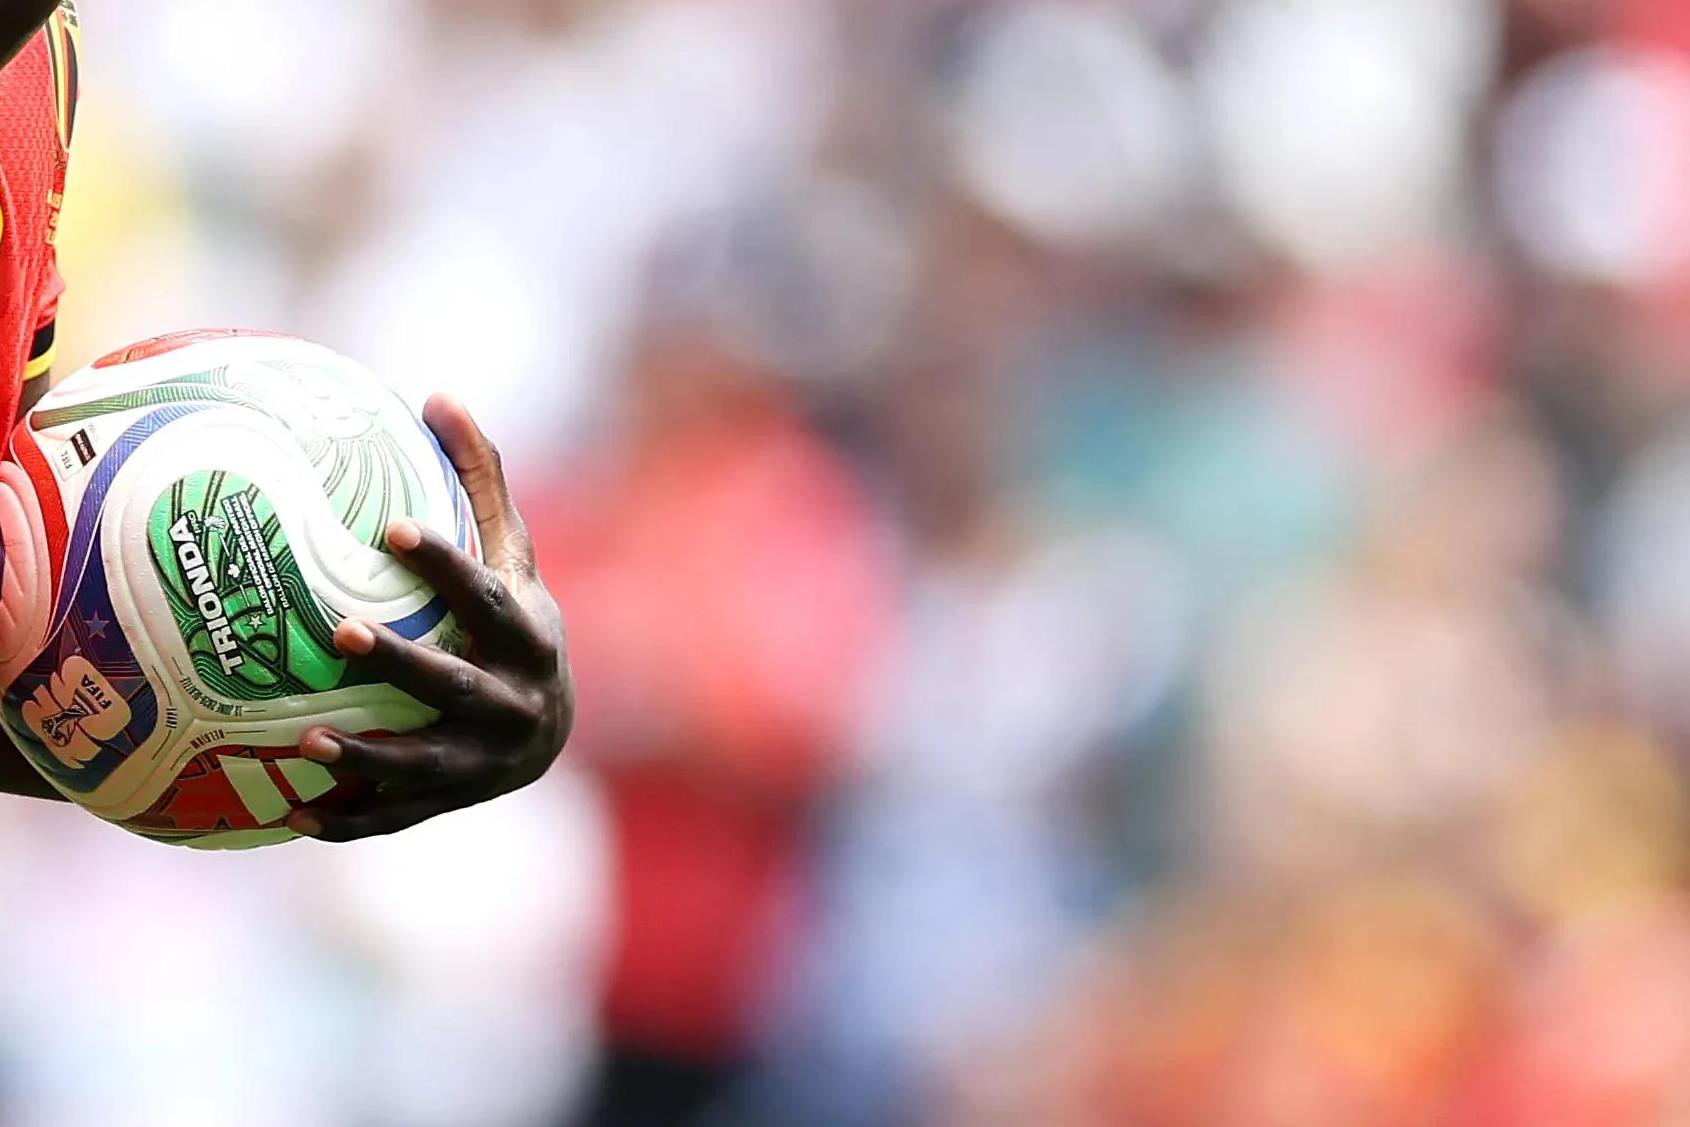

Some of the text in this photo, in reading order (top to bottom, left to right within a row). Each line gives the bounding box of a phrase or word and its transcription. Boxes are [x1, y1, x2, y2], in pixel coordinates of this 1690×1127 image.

[238, 517, 258, 549] MATCH
[251, 528, 270, 561] MATCH
[170, 515, 244, 675] TRIONDA
[270, 573, 289, 608] BALLON
[82, 674, 112, 709] FIFA
